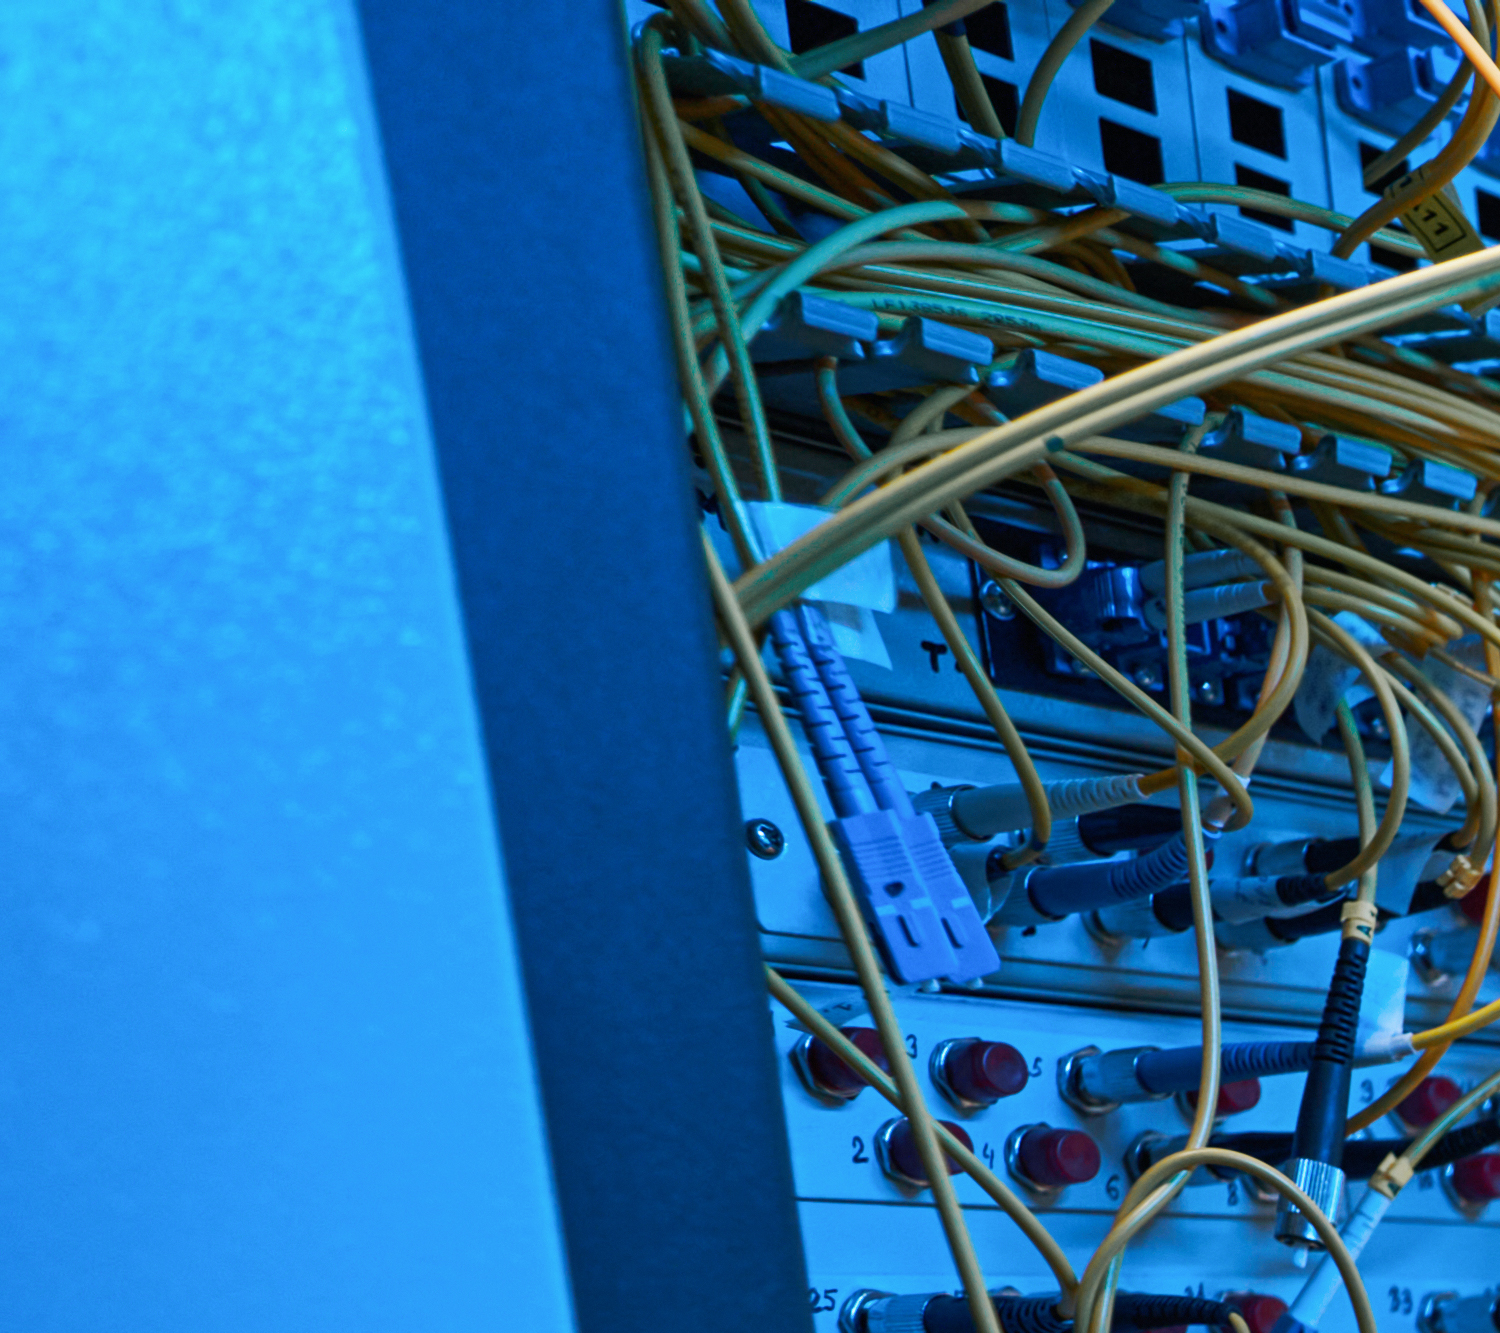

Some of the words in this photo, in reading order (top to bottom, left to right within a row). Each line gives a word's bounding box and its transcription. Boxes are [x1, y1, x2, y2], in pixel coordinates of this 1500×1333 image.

[906, 1034, 918, 1059] 3
[1028, 1056, 1043, 1077] 5
[852, 1135, 869, 1163] 2
[983, 1142, 995, 1169] 4
[1106, 1174, 1120, 1200] 6
[808, 1287, 839, 1313] 25
